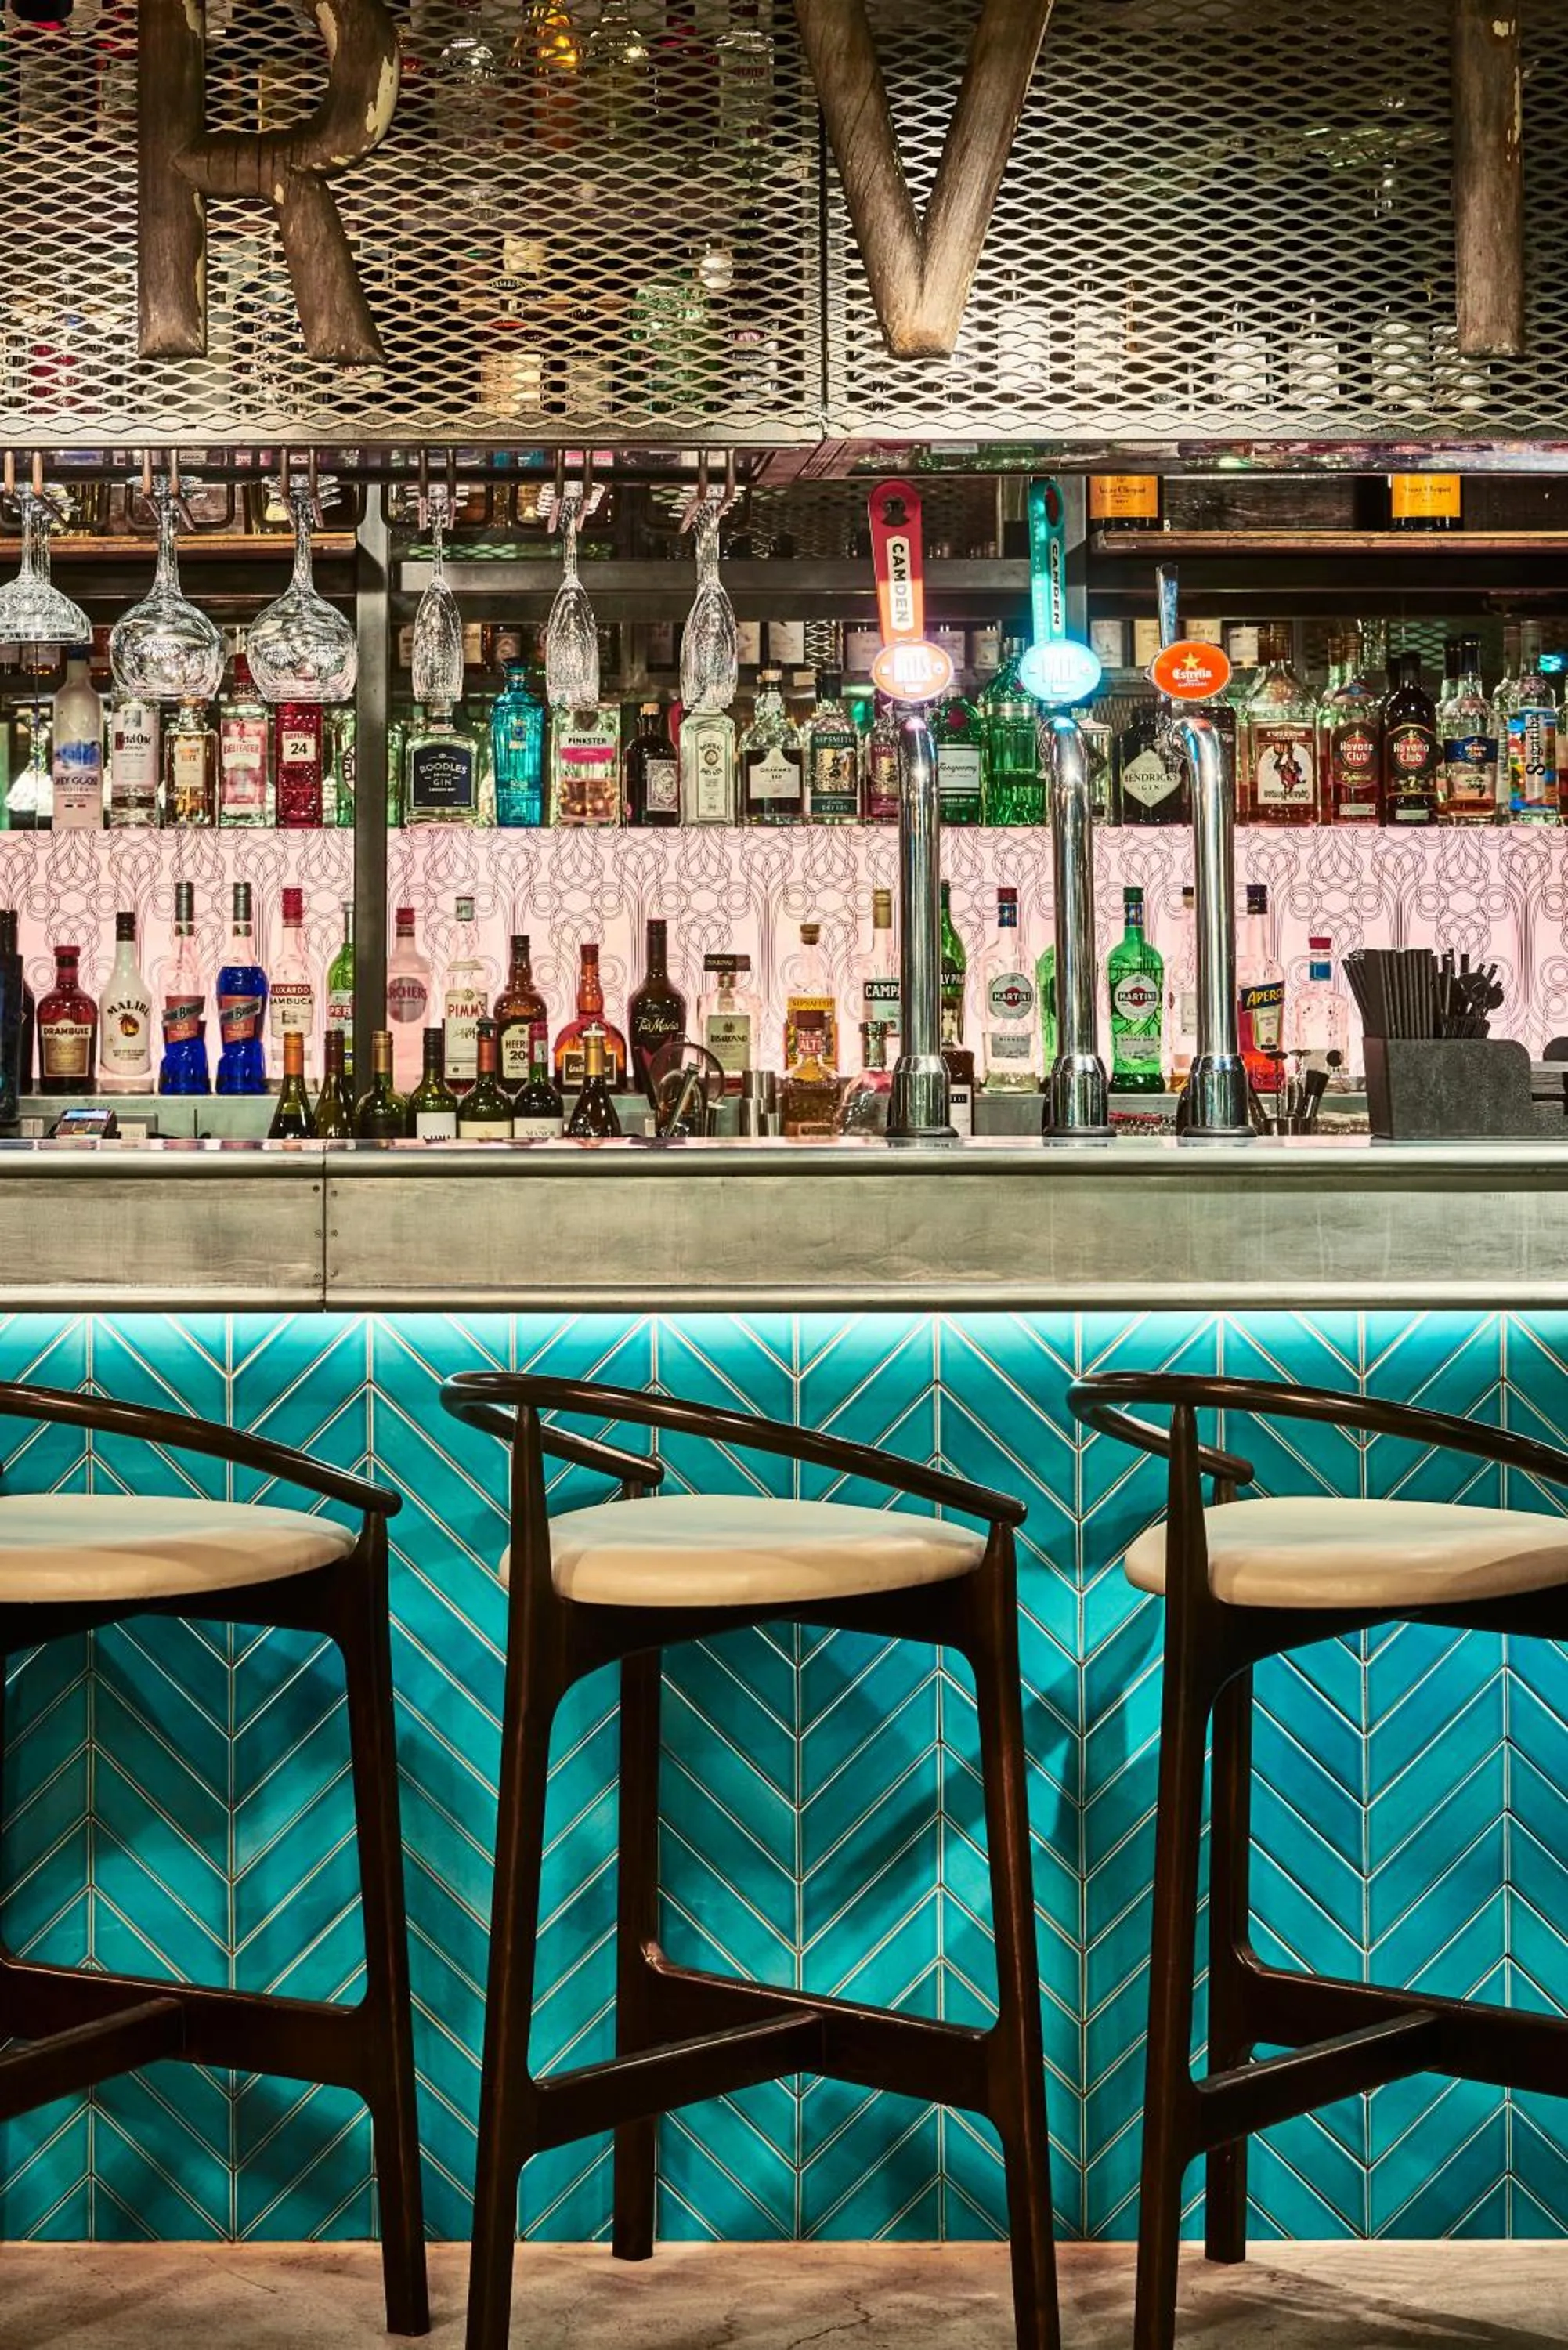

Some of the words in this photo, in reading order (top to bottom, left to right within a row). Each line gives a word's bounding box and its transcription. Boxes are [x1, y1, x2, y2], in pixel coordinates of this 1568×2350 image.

[891, 542, 909, 623] CAMDEN
[1051, 544, 1060, 624] CAMDEN
[1172, 667, 1212, 680] Estrella
[568, 736, 607, 745] PINKSTER
[291, 742, 307, 755] 24
[418, 761, 468, 775] BOODLES
[433, 778, 452, 786] GIN
[1407, 775, 1417, 787] 7
[865, 985, 900, 997] CAMP
[994, 992, 1031, 1001] MARTINI
[1119, 992, 1156, 1001] MARTINI
[1246, 988, 1284, 1007] APERO
[107, 1000, 151, 1017] MALIBU
[329, 1007, 352, 1016] PER
[447, 1001, 487, 1018] PIMM'S
[43, 1026, 89, 1035] DRAMBUIE
[636, 1016, 651, 1033] Tia
[650, 1016, 679, 1034] Maria
[505, 1039, 528, 1049] HEER
[509, 1050, 528, 1061] 20
